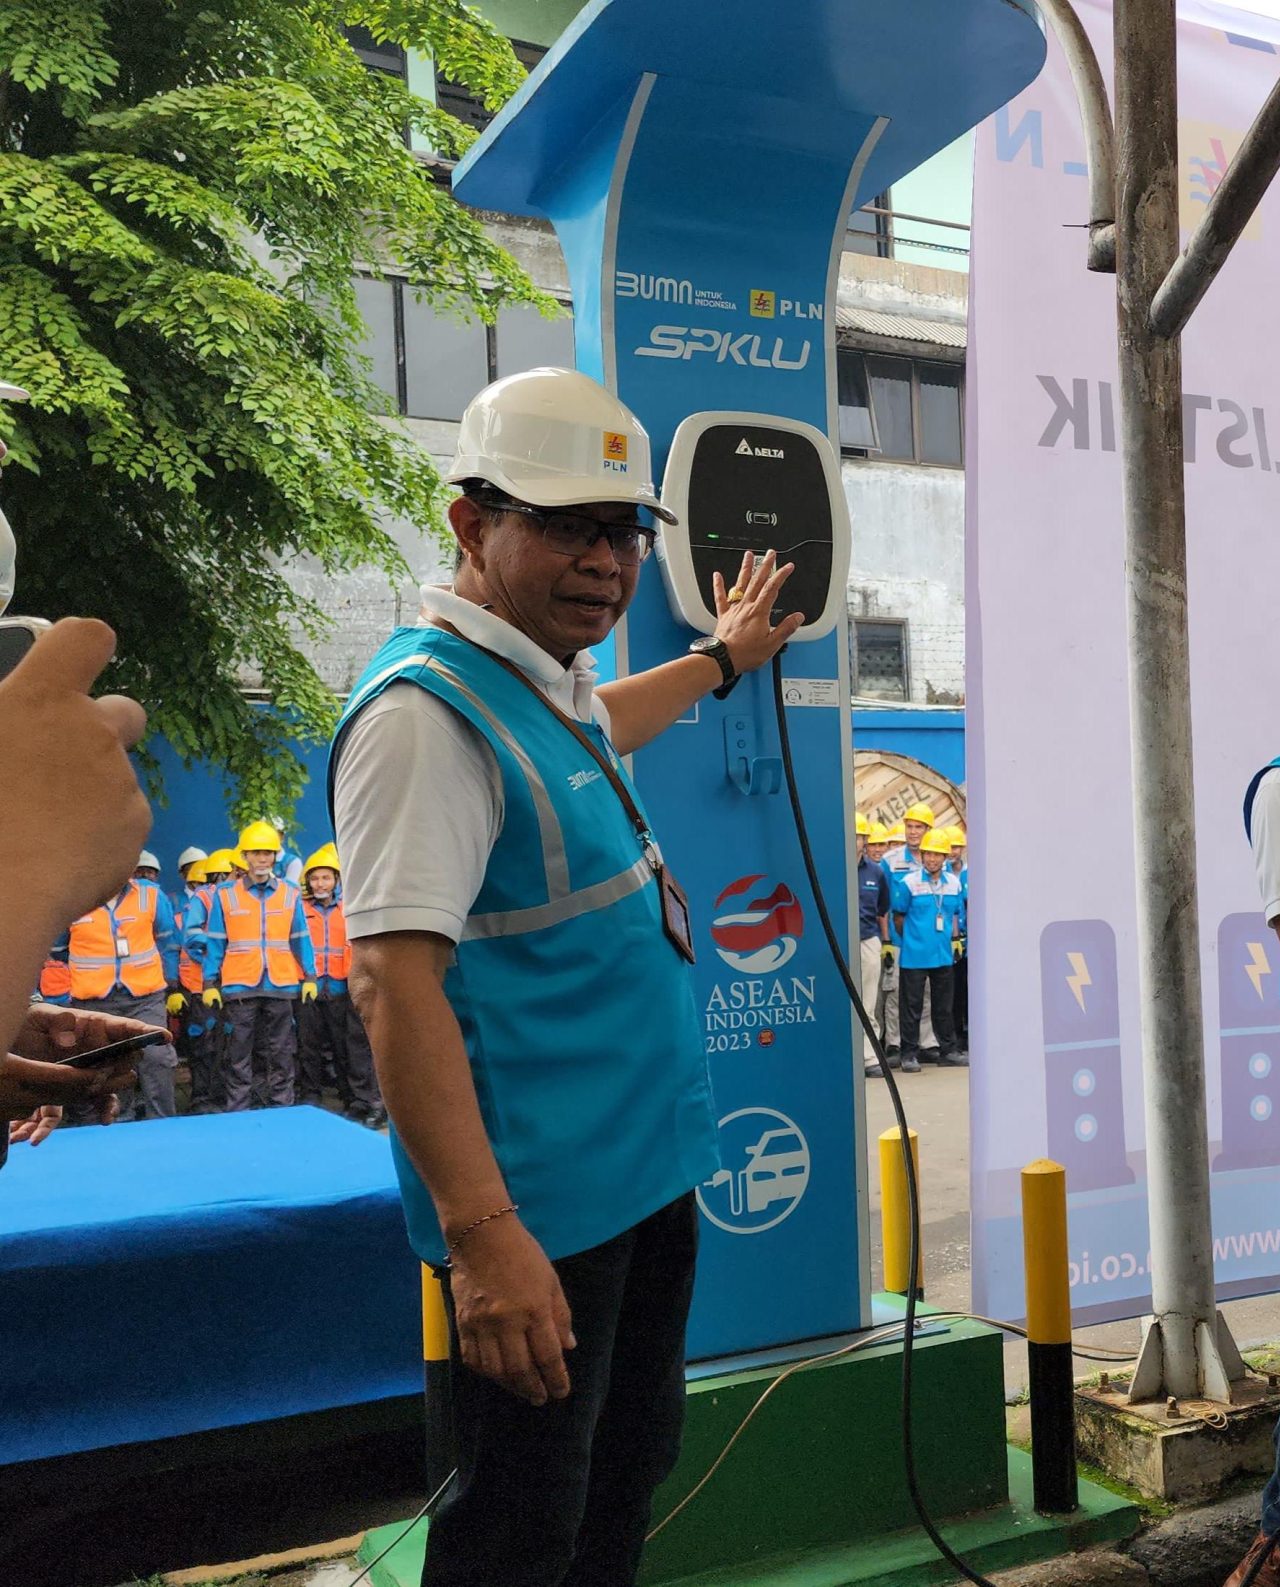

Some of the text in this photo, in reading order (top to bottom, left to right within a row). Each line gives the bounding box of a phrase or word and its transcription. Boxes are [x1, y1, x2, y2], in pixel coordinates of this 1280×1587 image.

[616, 271, 693, 305] BUMN
[695, 290, 723, 300] UNTUK
[695, 298, 737, 311] INDONESIA
[779, 299, 824, 320] PLN
[634, 325, 811, 370] SPKLU
[754, 447, 785, 459] DELTA
[603, 460, 627, 472] PLN
[706, 976, 816, 1012] ASEAN
[705, 1006, 817, 1031] INDONESIA
[706, 1032, 751, 1053] 2023
